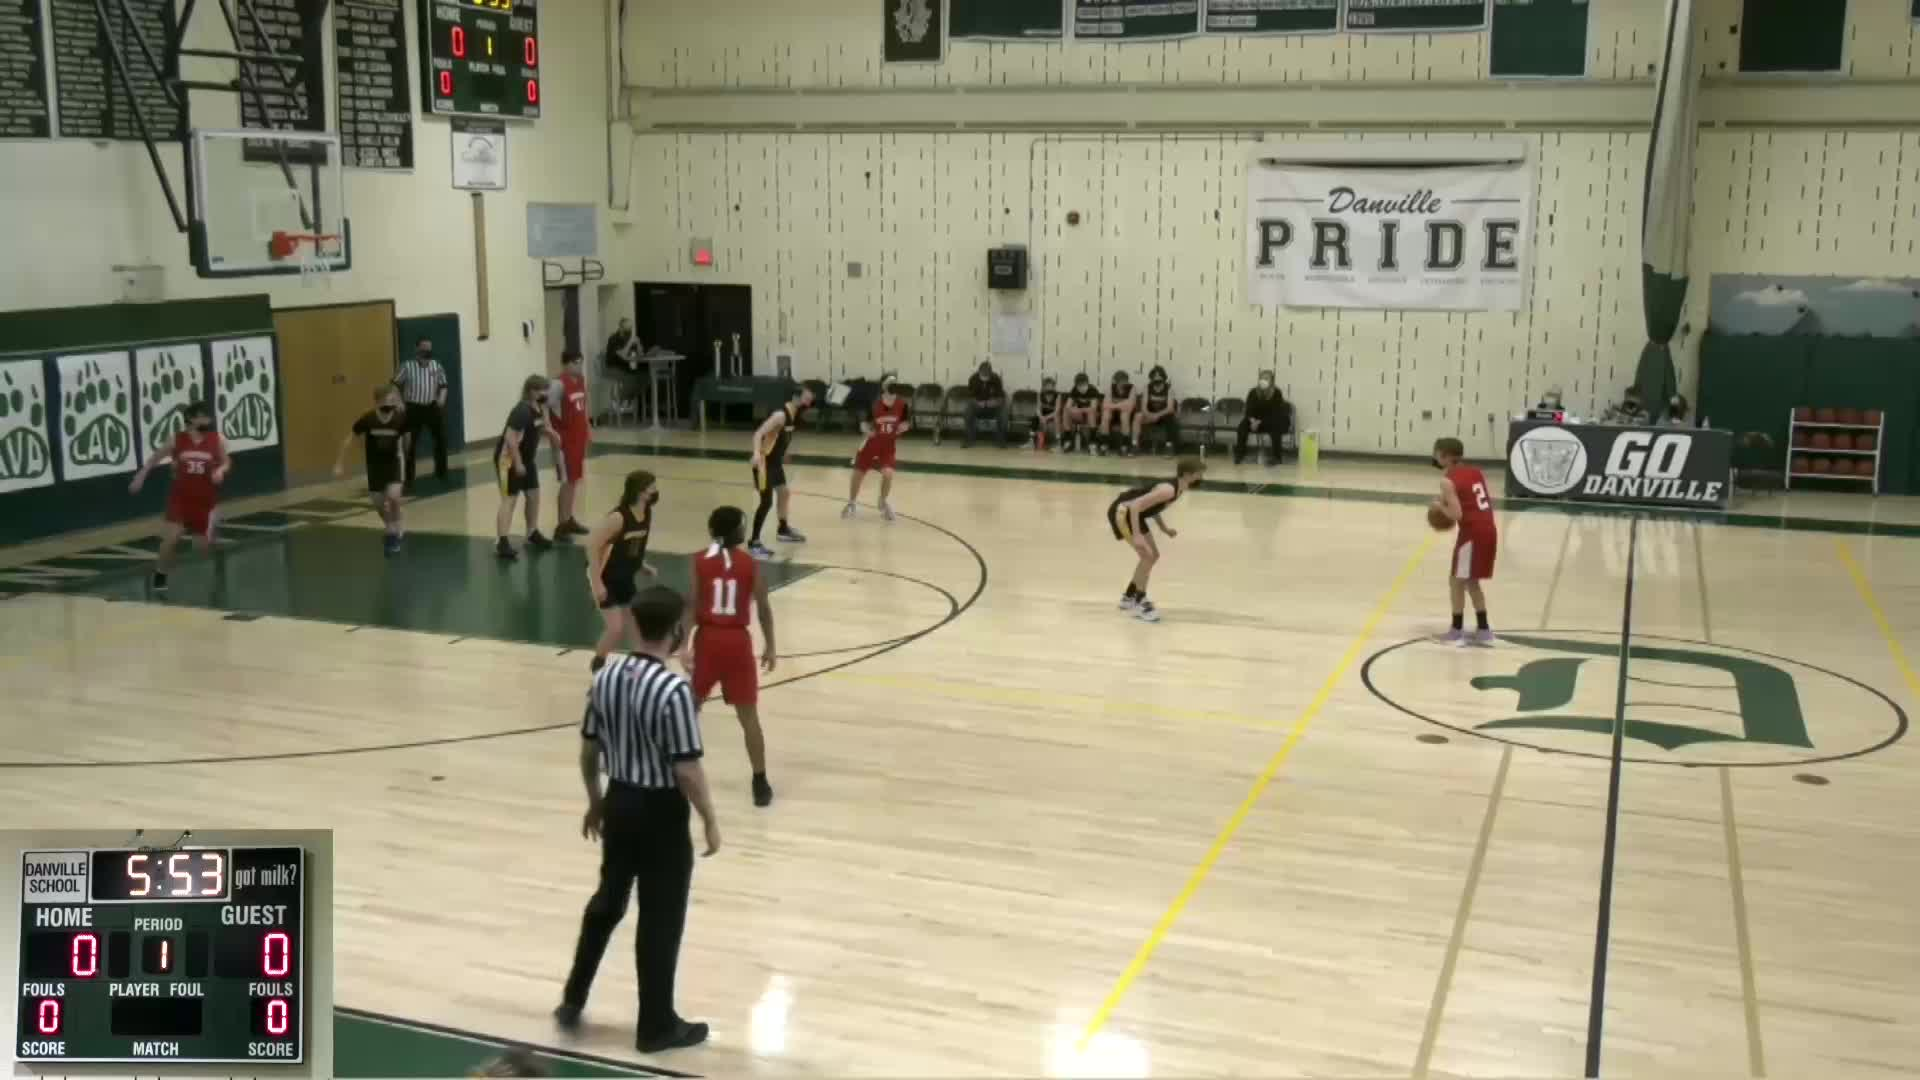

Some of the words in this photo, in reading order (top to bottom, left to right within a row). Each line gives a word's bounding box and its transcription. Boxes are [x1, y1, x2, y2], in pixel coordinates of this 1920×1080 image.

[451, 26, 464, 58] 0
[524, 37, 536, 66] 0
[440, 71, 451, 94] 0
[527, 79, 538, 102] 0
[1328, 186, 1442, 215] Danville
[1256, 217, 1520, 273] PRIDE
[1604, 431, 1693, 479] GO
[1471, 482, 1490, 512] 2
[1582, 474, 1723, 502] DANVILLE
[711, 577, 737, 616] 11
